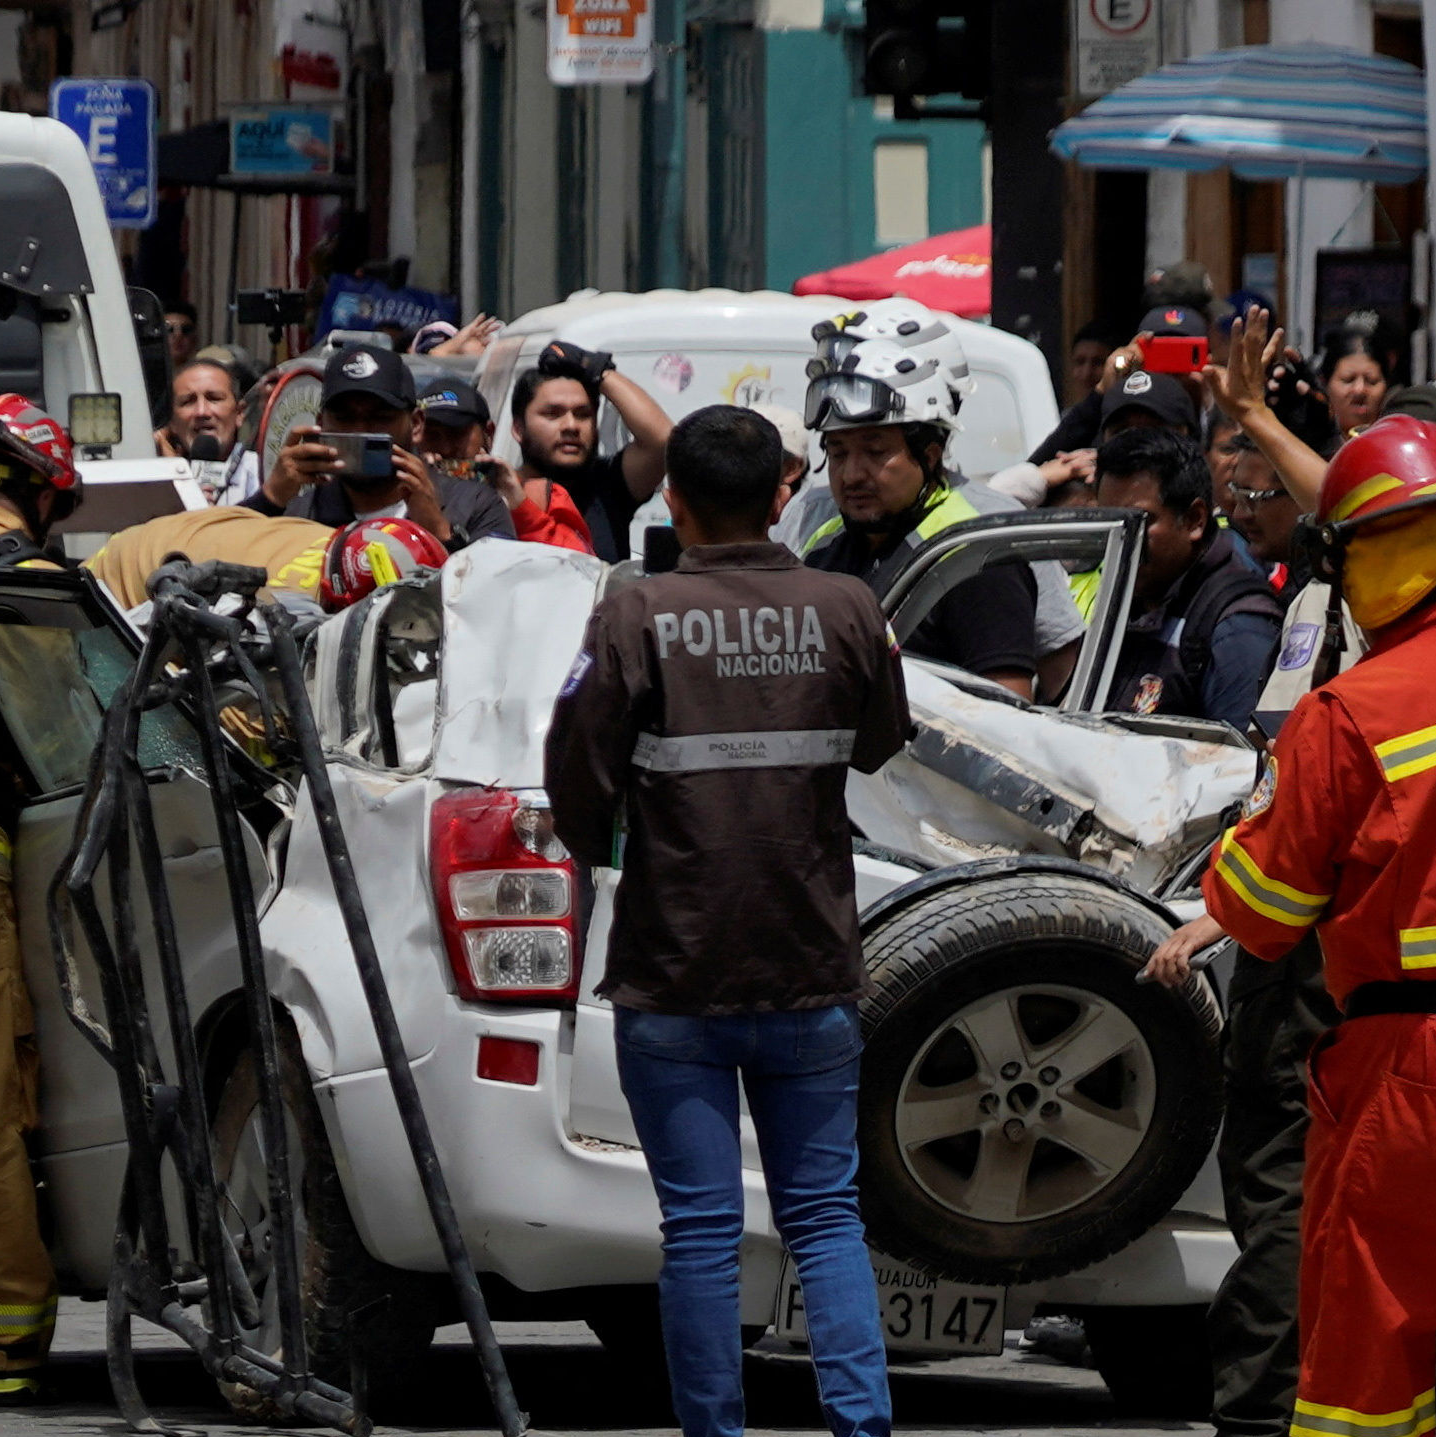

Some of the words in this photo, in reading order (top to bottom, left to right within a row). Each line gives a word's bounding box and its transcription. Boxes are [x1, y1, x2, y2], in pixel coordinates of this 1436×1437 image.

[88, 115, 119, 164] E
[654, 605, 826, 659] POLICIA
[716, 653, 827, 677] NACIONAL
[875, 1269, 938, 1290] UADOR
